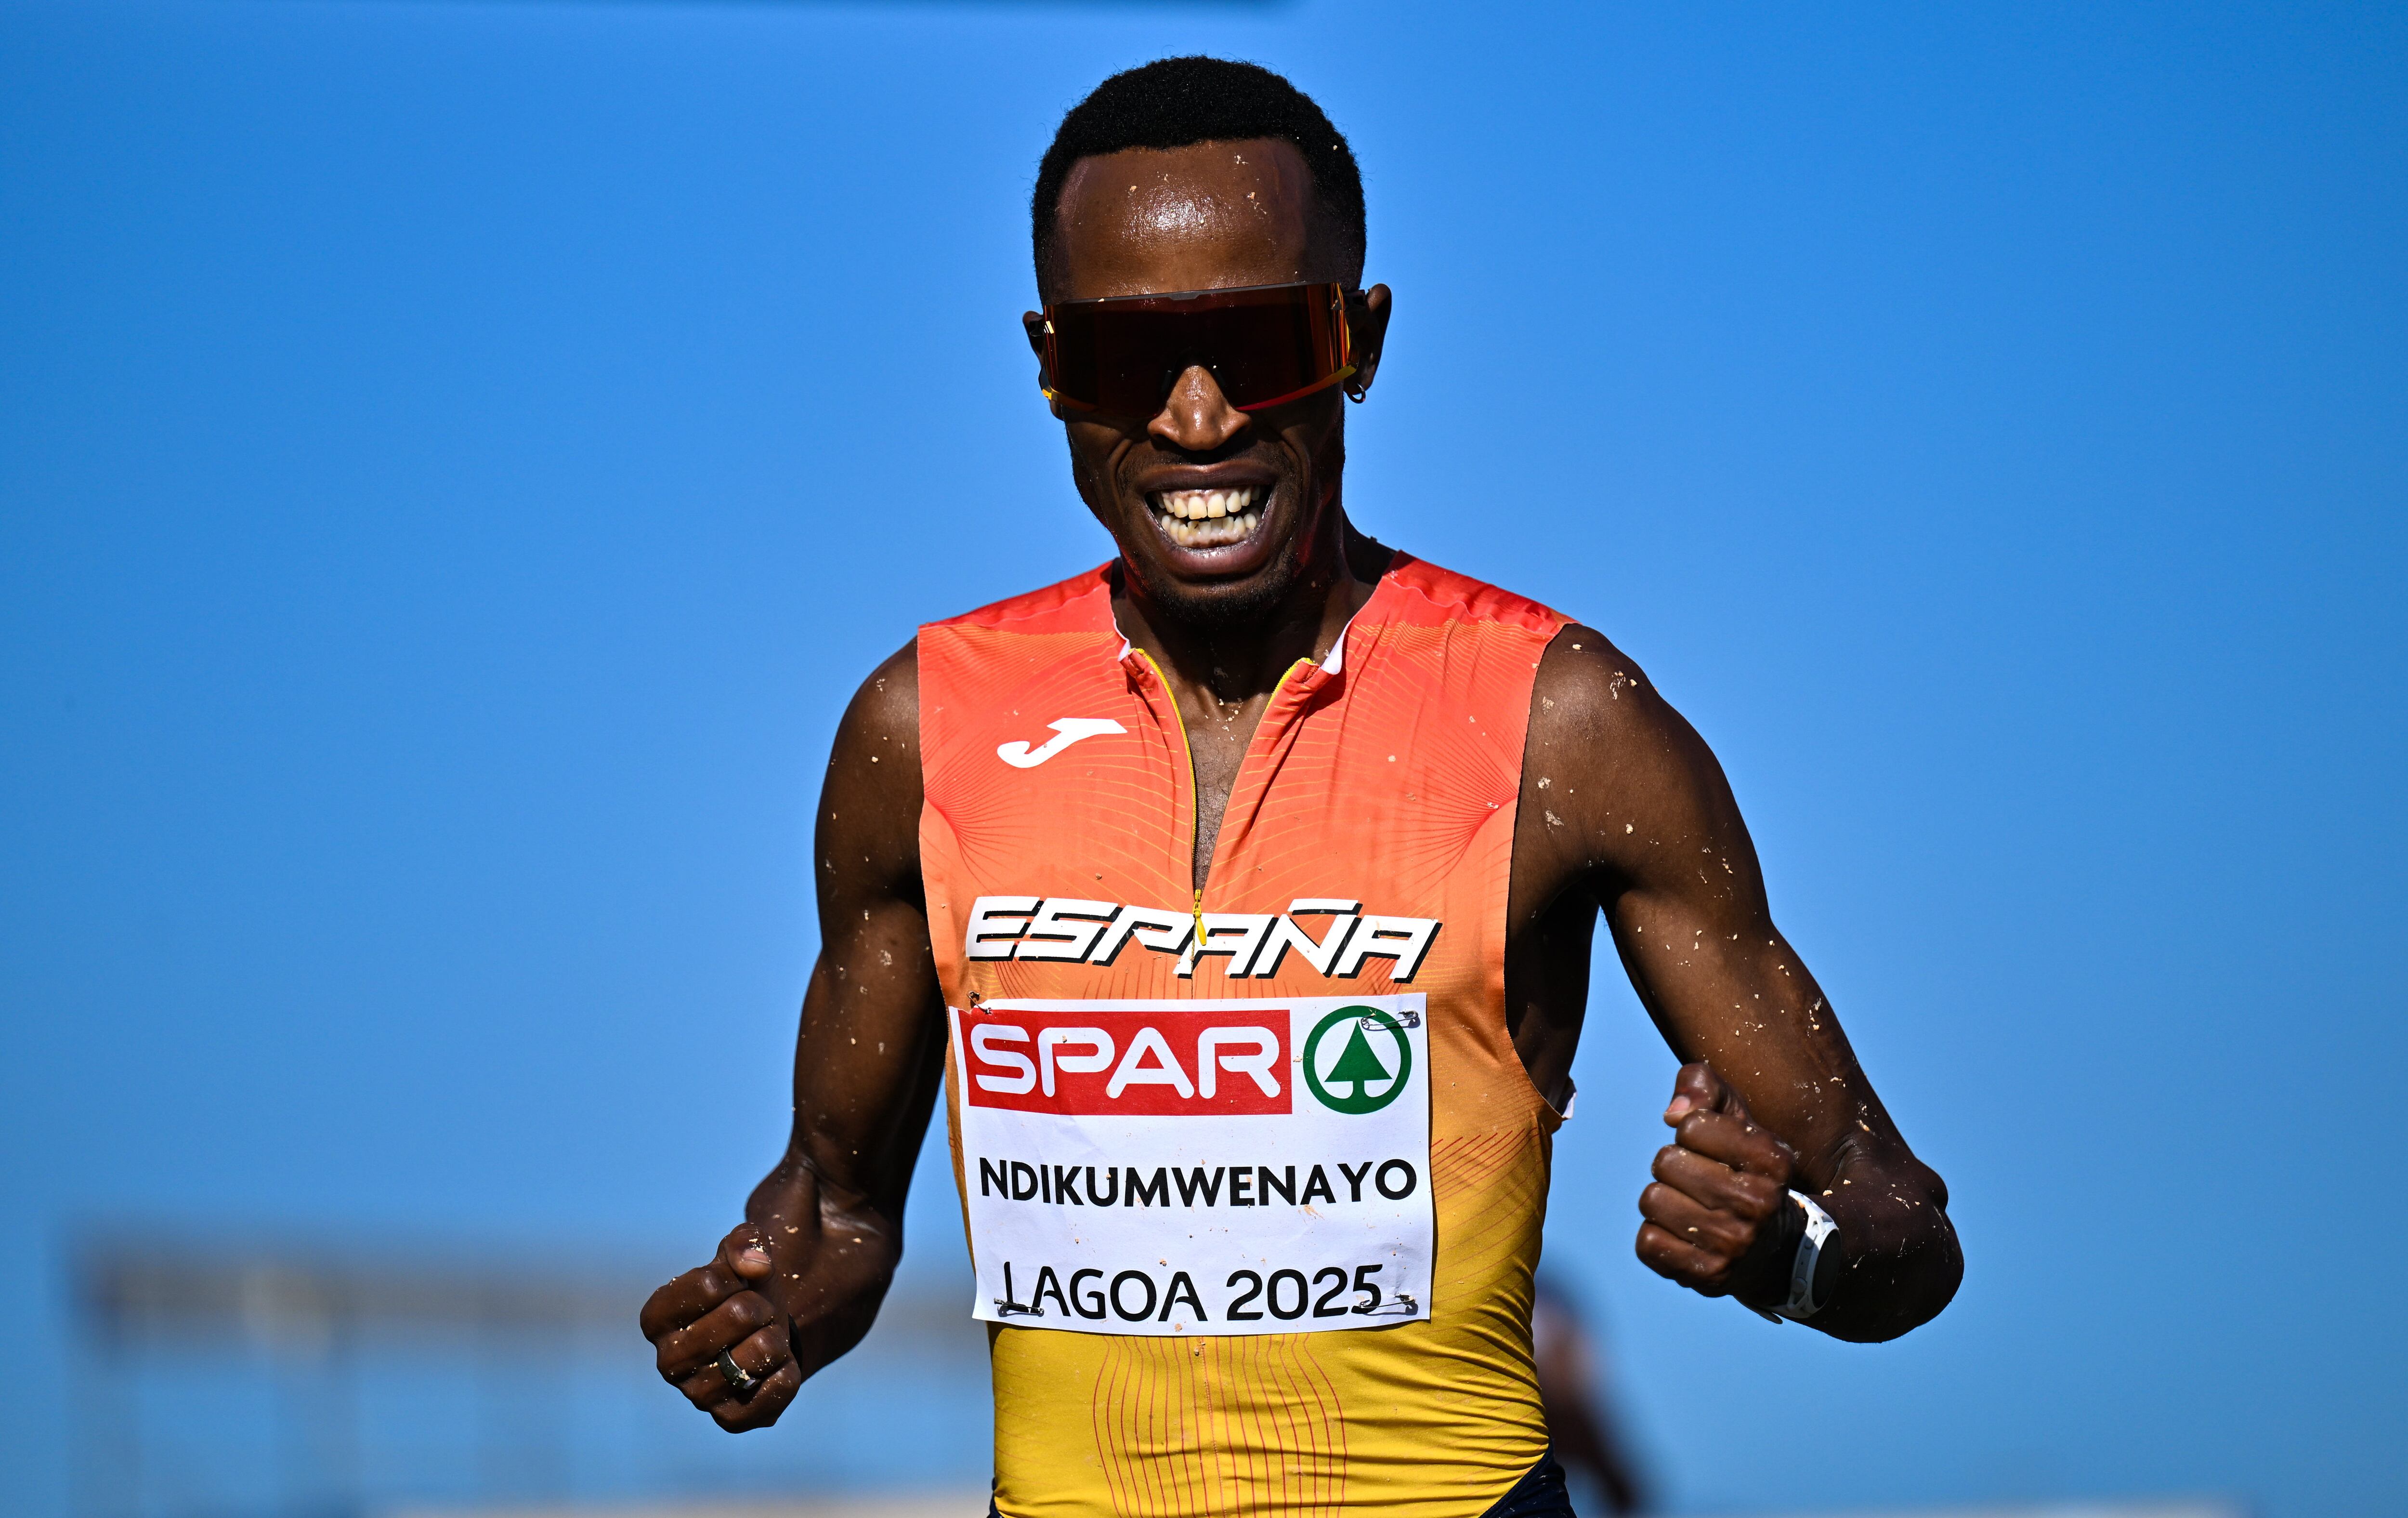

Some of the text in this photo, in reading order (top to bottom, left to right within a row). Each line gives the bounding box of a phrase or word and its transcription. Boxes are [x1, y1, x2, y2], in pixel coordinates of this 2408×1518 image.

[966, 896, 1442, 984] ESPAÑA
[970, 1025, 1281, 1099] SPAR
[979, 1157, 1417, 1208] NDIKUMWENAYO
[1003, 1261, 1383, 1322] LAGOA 2025
